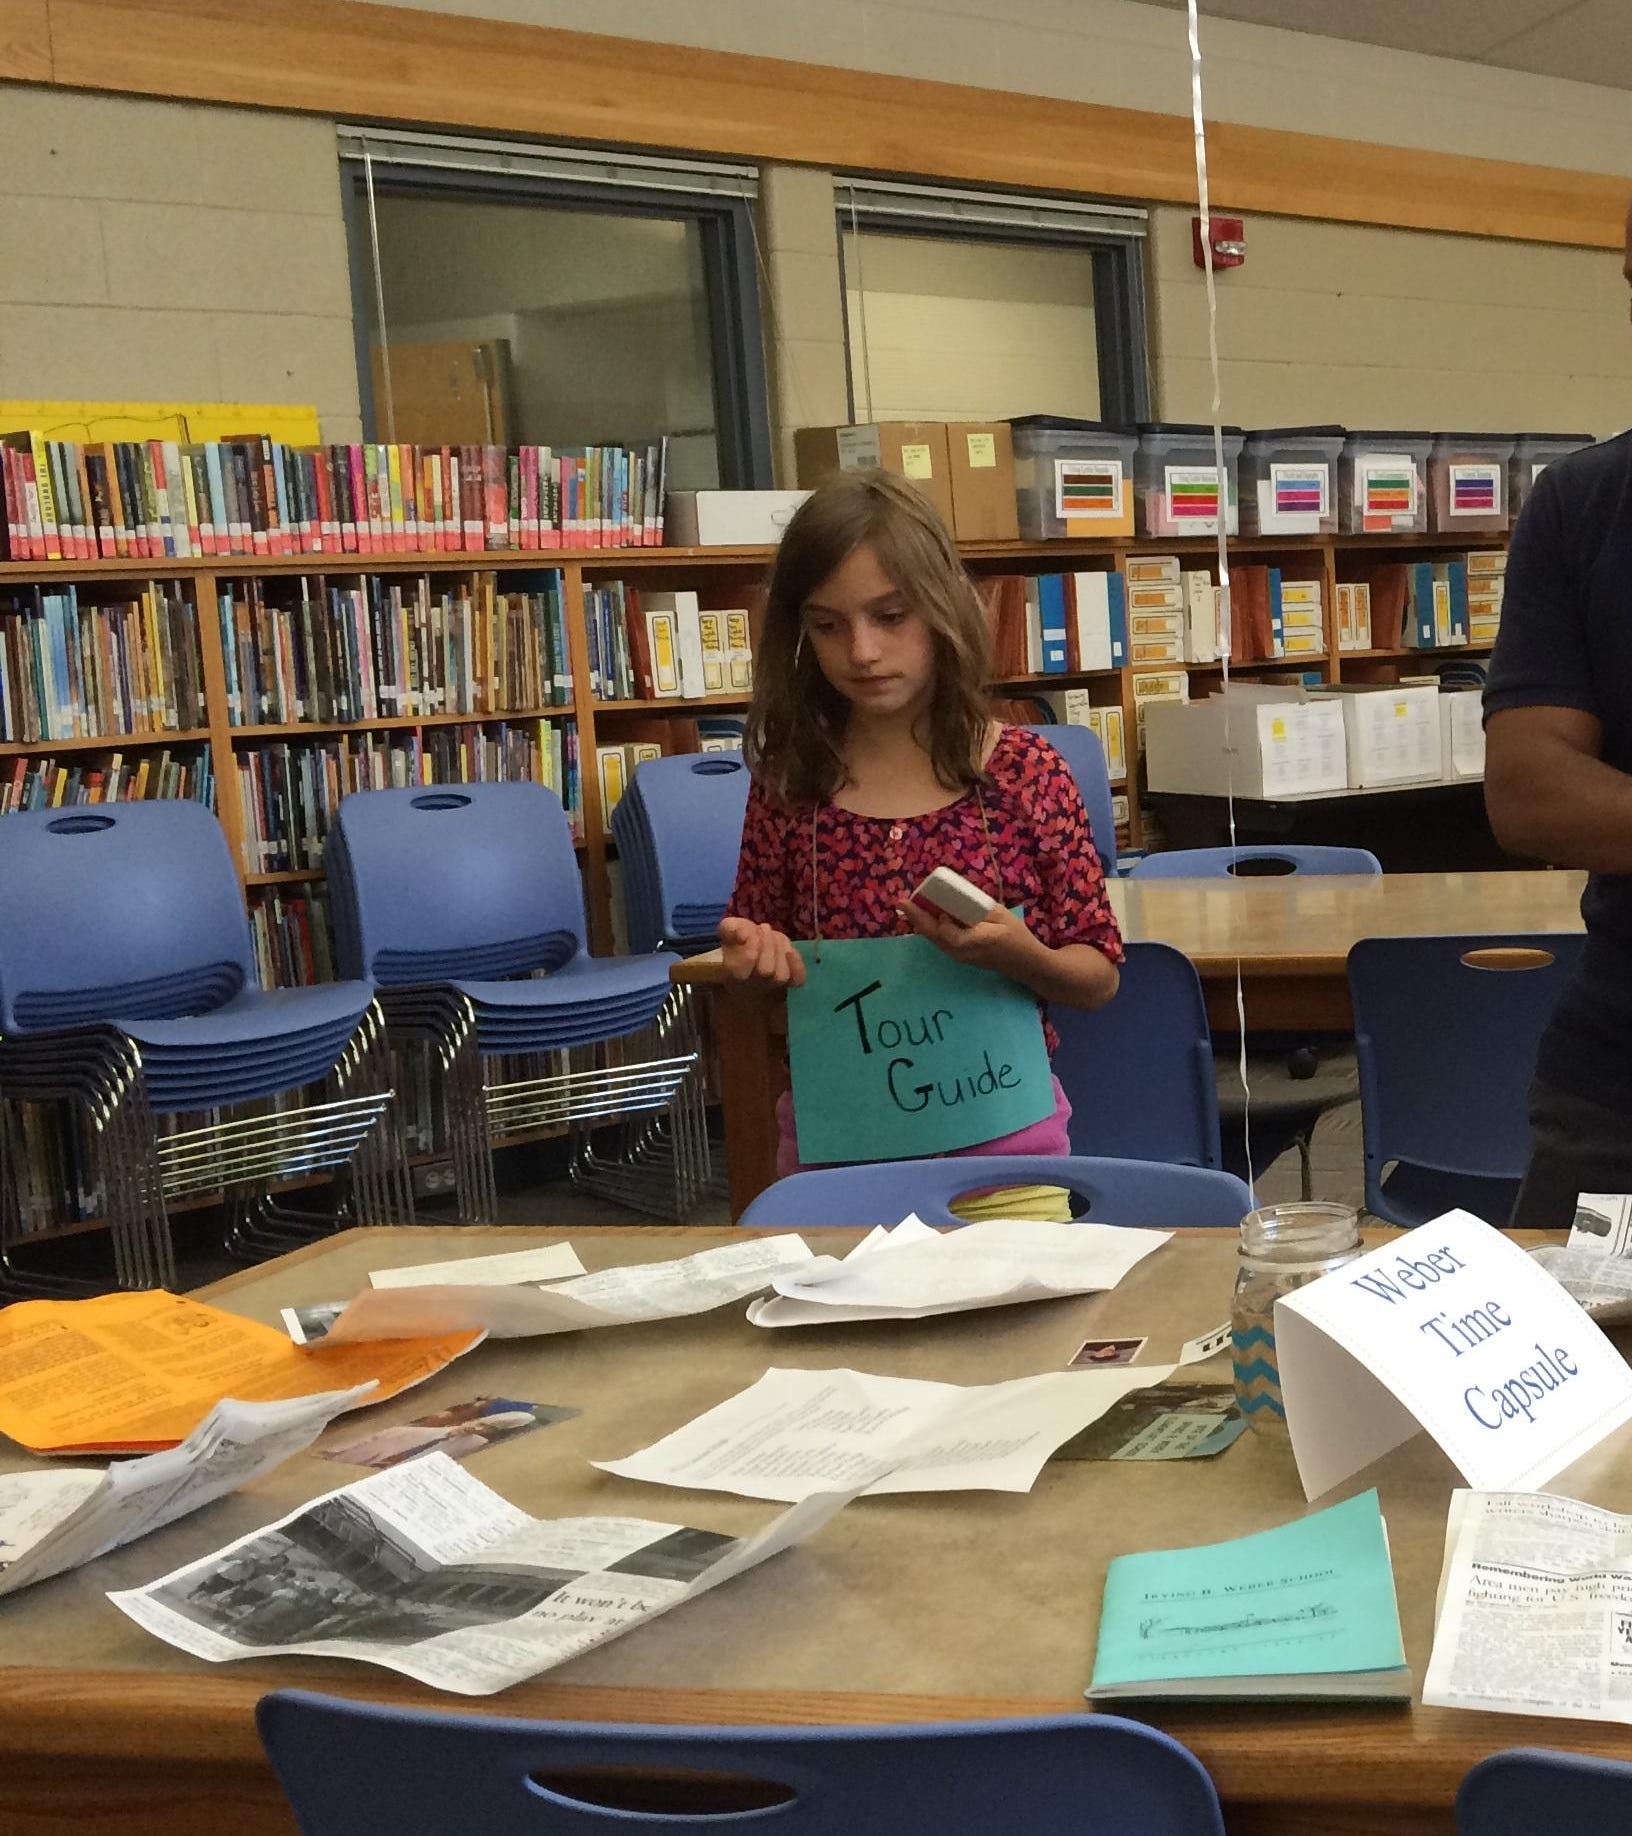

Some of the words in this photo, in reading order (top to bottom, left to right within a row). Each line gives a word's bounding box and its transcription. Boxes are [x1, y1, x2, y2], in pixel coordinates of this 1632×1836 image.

[833, 980, 954, 1054] Tour
[887, 1050, 1022, 1113] Guide
[1352, 1246, 1466, 1306] Weber
[1420, 1298, 1512, 1358] Time
[1463, 1344, 1578, 1430] Capsule
[1469, 1575, 1503, 1589] Area
[1508, 1581, 1540, 1594] men
[1471, 1563, 1566, 1584] Remembering
[1568, 1573, 1607, 1583] World
